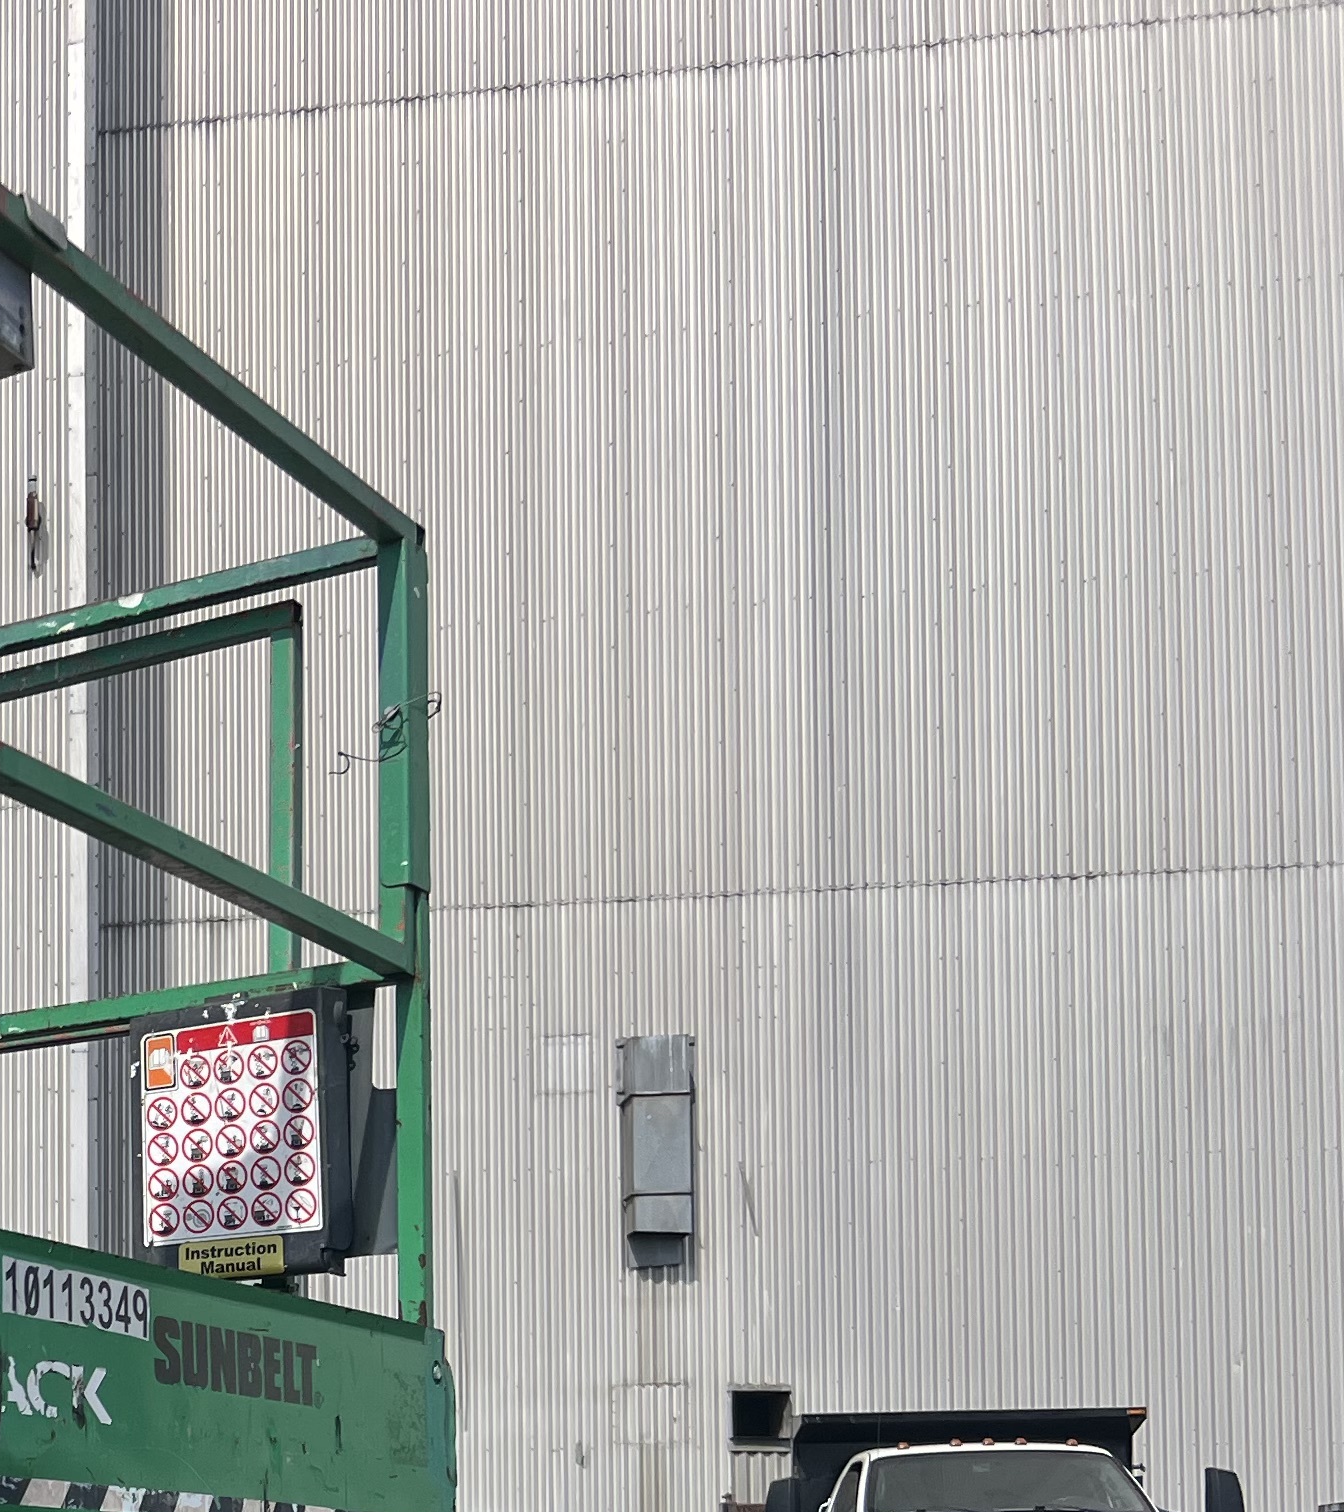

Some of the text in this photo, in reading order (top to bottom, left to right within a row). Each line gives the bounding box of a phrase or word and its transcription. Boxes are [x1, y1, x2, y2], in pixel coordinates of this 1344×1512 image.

[185, 1242, 277, 1260] Instruction
[200, 1257, 261, 1275] Manual
[5, 1261, 149, 1338] 10113349
[153, 1316, 318, 1407] SUNBELT
